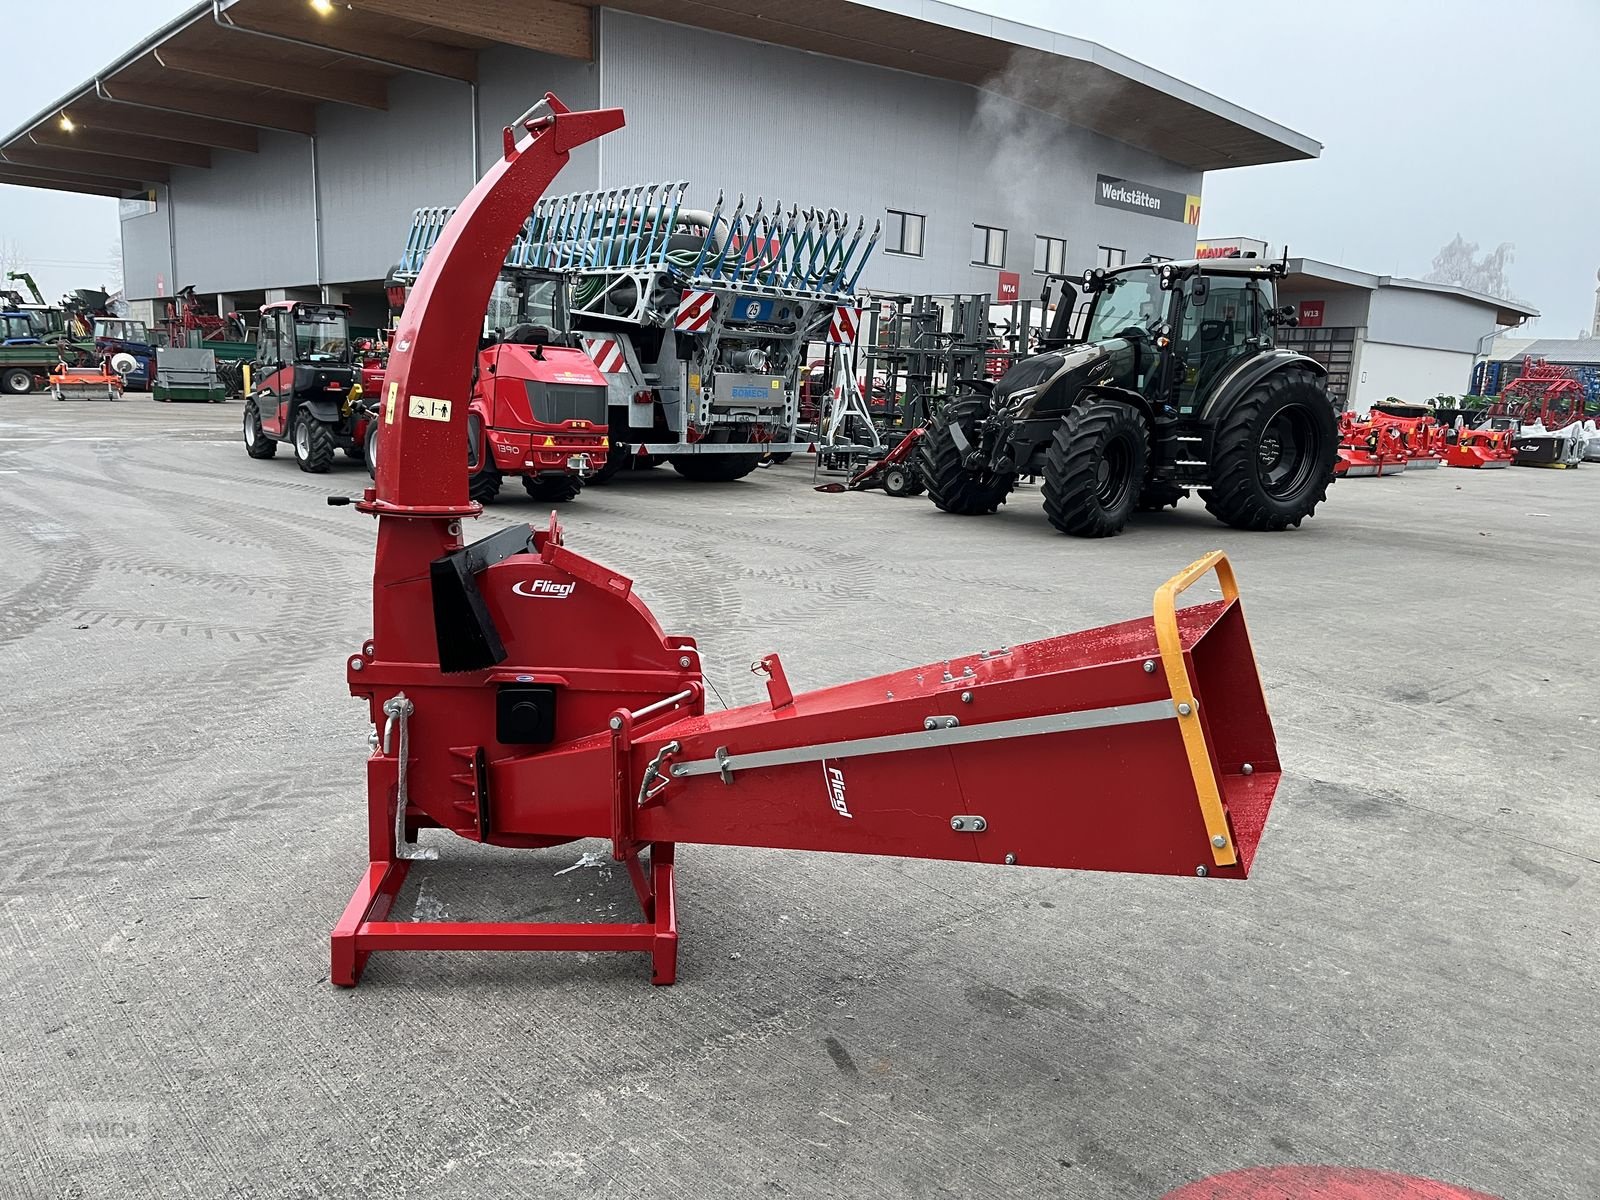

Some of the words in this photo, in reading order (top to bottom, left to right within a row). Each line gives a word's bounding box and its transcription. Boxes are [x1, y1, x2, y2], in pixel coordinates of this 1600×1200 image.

[1102, 183, 1160, 210] Werkstätten
[1002, 283, 1016, 294] W14
[748, 304, 759, 316] 25
[1303, 309, 1319, 318] W13
[732, 388, 769, 399] BOMECH
[497, 444, 520, 455] 1390
[531, 579, 576, 596] Fliegl
[828, 767, 853, 819] Fliegl
